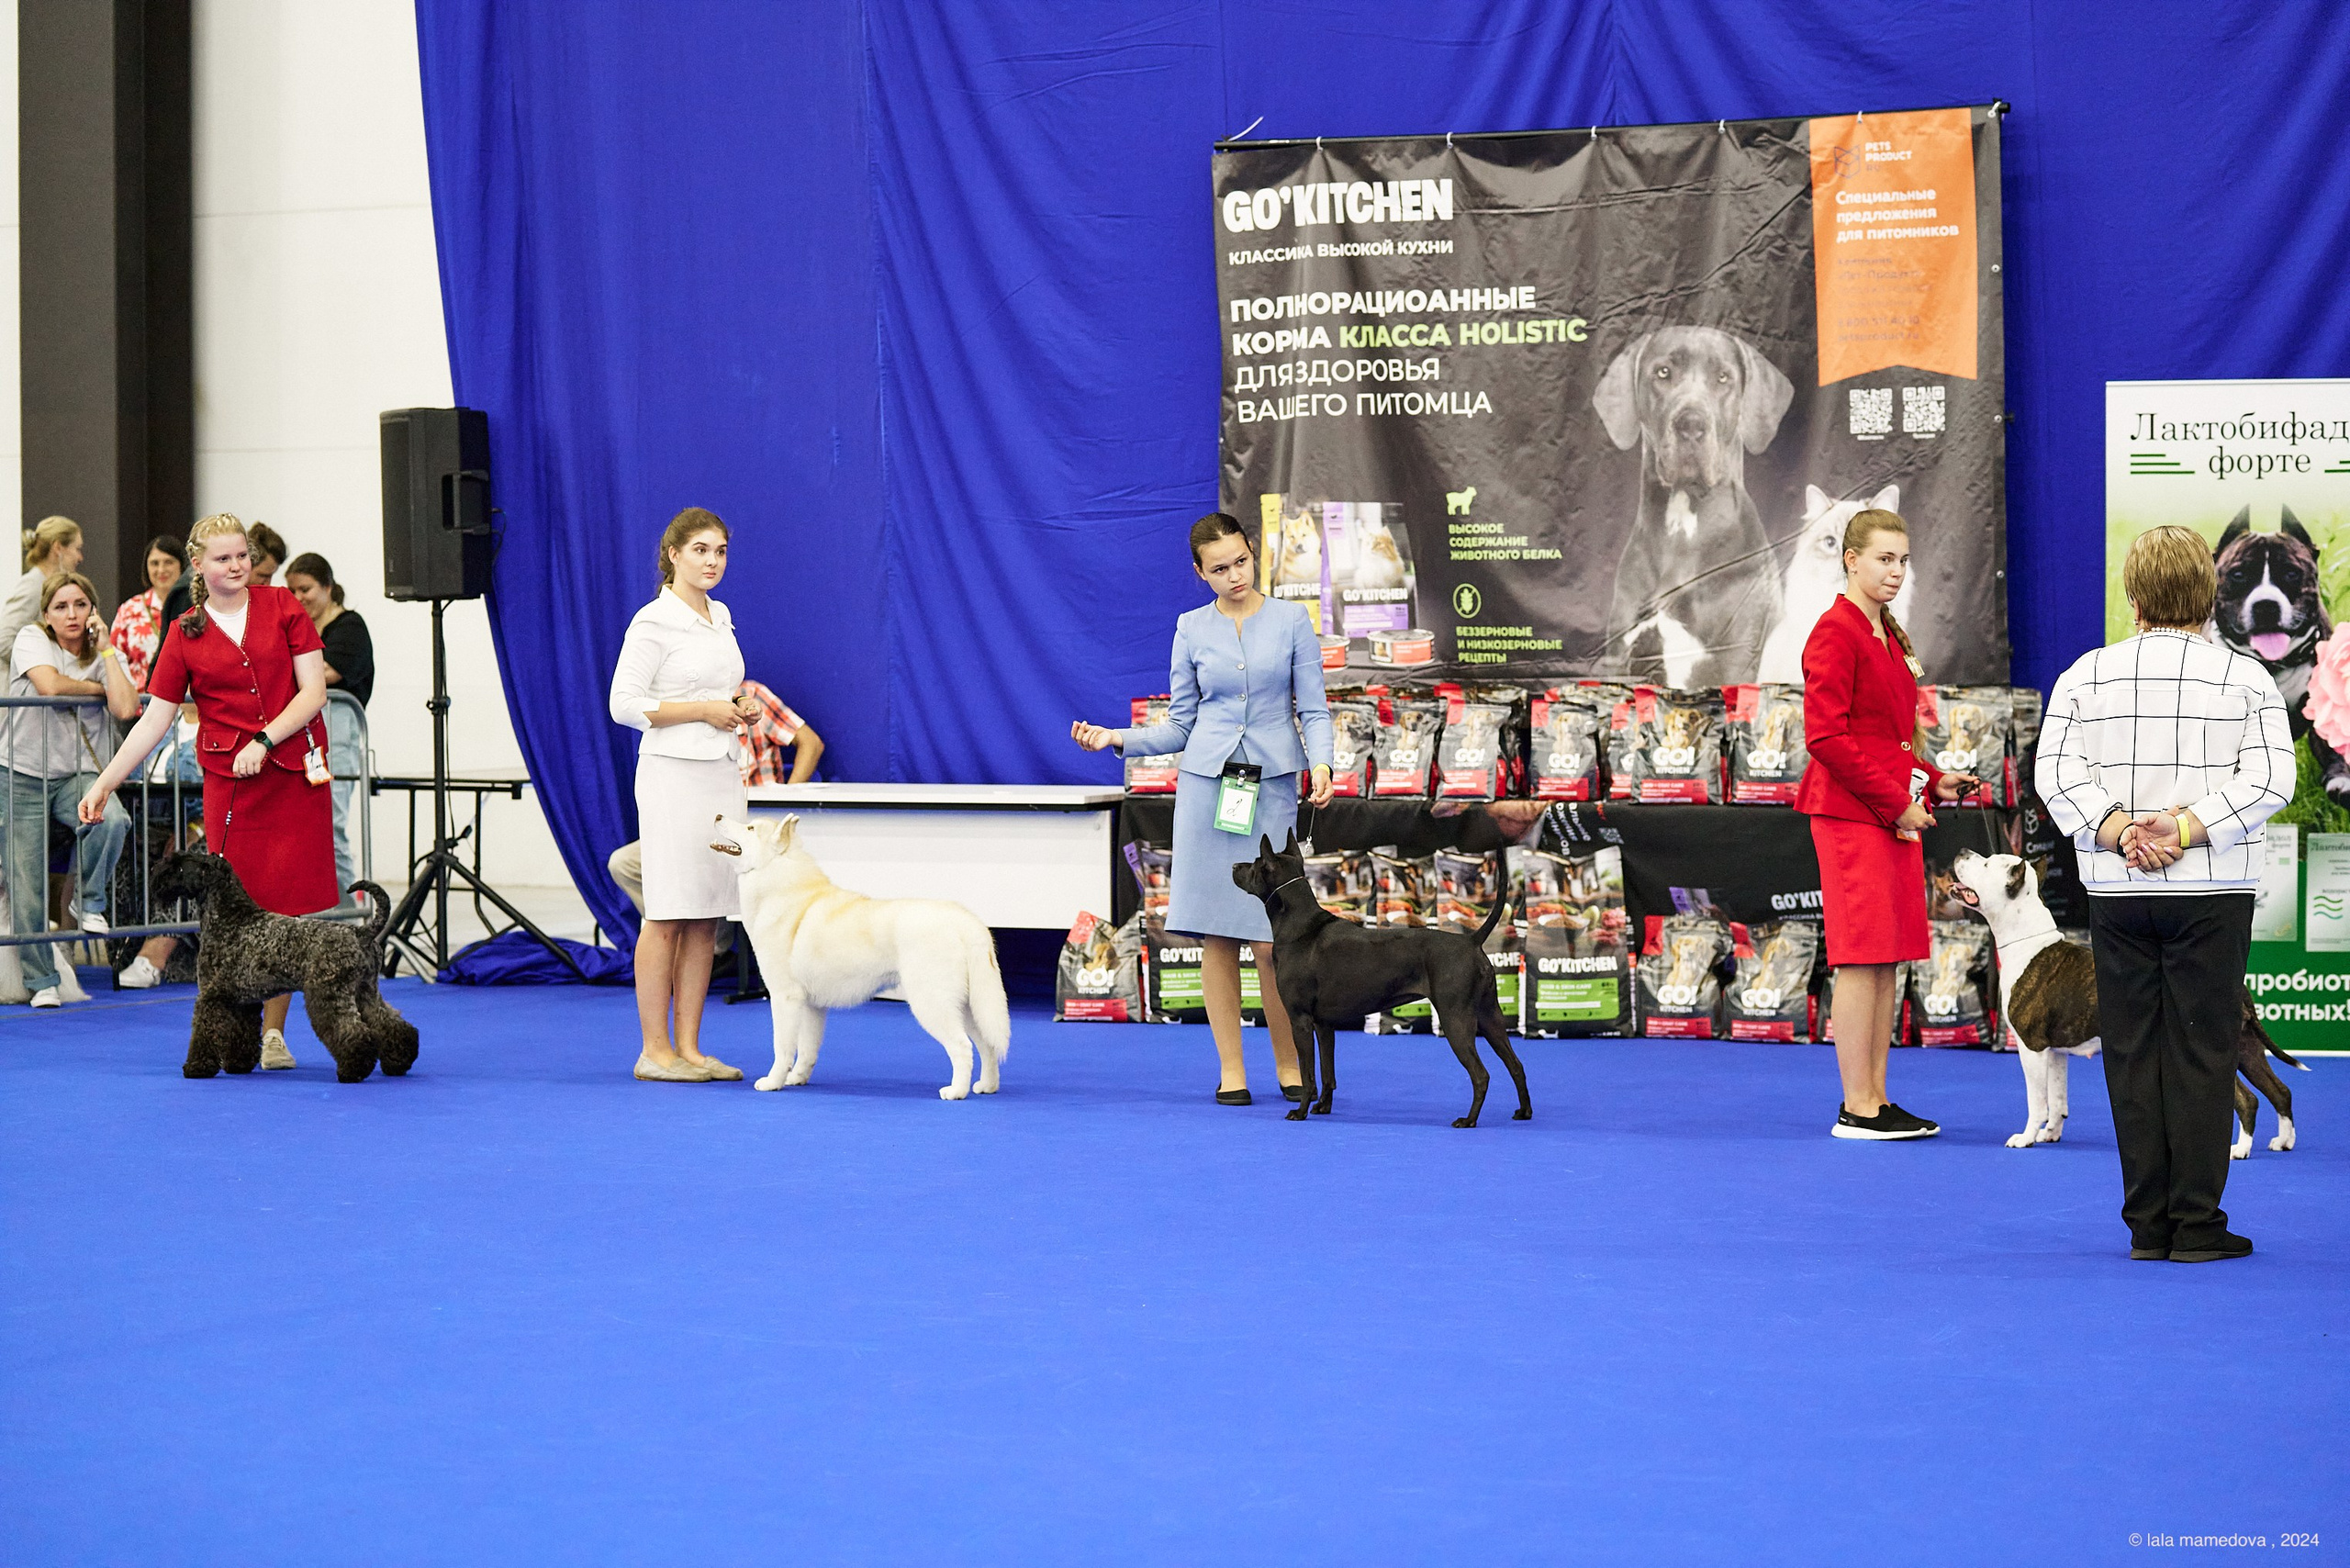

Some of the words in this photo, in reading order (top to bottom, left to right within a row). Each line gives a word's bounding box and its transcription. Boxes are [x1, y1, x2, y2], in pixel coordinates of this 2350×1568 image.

[1865, 141, 1891, 151] PETS
[1865, 151, 1912, 162] PRODUCT
[1223, 178, 1453, 233] GO'KITCHEN
[1836, 189, 1936, 206] Специальные
[1837, 207, 1937, 226] предложения
[1837, 229, 1863, 244] для
[1867, 225, 1960, 241] питомников
[1228, 244, 1313, 266] КЛАССИКА
[1317, 239, 1394, 258] ВЫСОКОЙ
[1397, 240, 1453, 256] КУХНИ
[1230, 286, 1537, 322] ПОЛНОРАЦИОАННЫЕ
[1232, 326, 1332, 356] КОРМА
[1339, 324, 1451, 349] КЛАССА
[1460, 319, 1588, 346] HOLISTIC
[1237, 394, 1347, 423] ВАШЕГО
[1357, 391, 1493, 419] ПИТОМЦА
[2130, 411, 2350, 446] Лактобифад
[2209, 445, 2311, 480] форте
[1449, 523, 1505, 535] ВЫСОКОЕ
[1449, 536, 1528, 548] СОДЕРЖАНИЕ
[1450, 550, 1519, 561] ЖИВОТНОГО
[1522, 548, 1562, 560] БЕЛКА
[1456, 626, 1533, 637] БЕЗЗЕРНОВЫЕ
[1458, 640, 1465, 650] И
[1466, 639, 1562, 651] НИЗКОЗЕРНОВЫЕ
[1458, 652, 1507, 664] РЕЦЕПТЫ
[1390, 748, 1418, 763] GO!
[1455, 748, 1485, 763] GO!
[1549, 753, 1580, 769] GO!
[1653, 746, 1695, 766] GO!
[1746, 749, 1786, 769] GO!
[1936, 748, 1977, 770] GO!
[1538, 957, 1617, 973] GO'KITCHEN
[1076, 967, 1114, 987] GO!
[1657, 984, 1698, 1005] GO!
[1741, 988, 1781, 1008] GO!
[1924, 993, 1959, 1015] GO!
